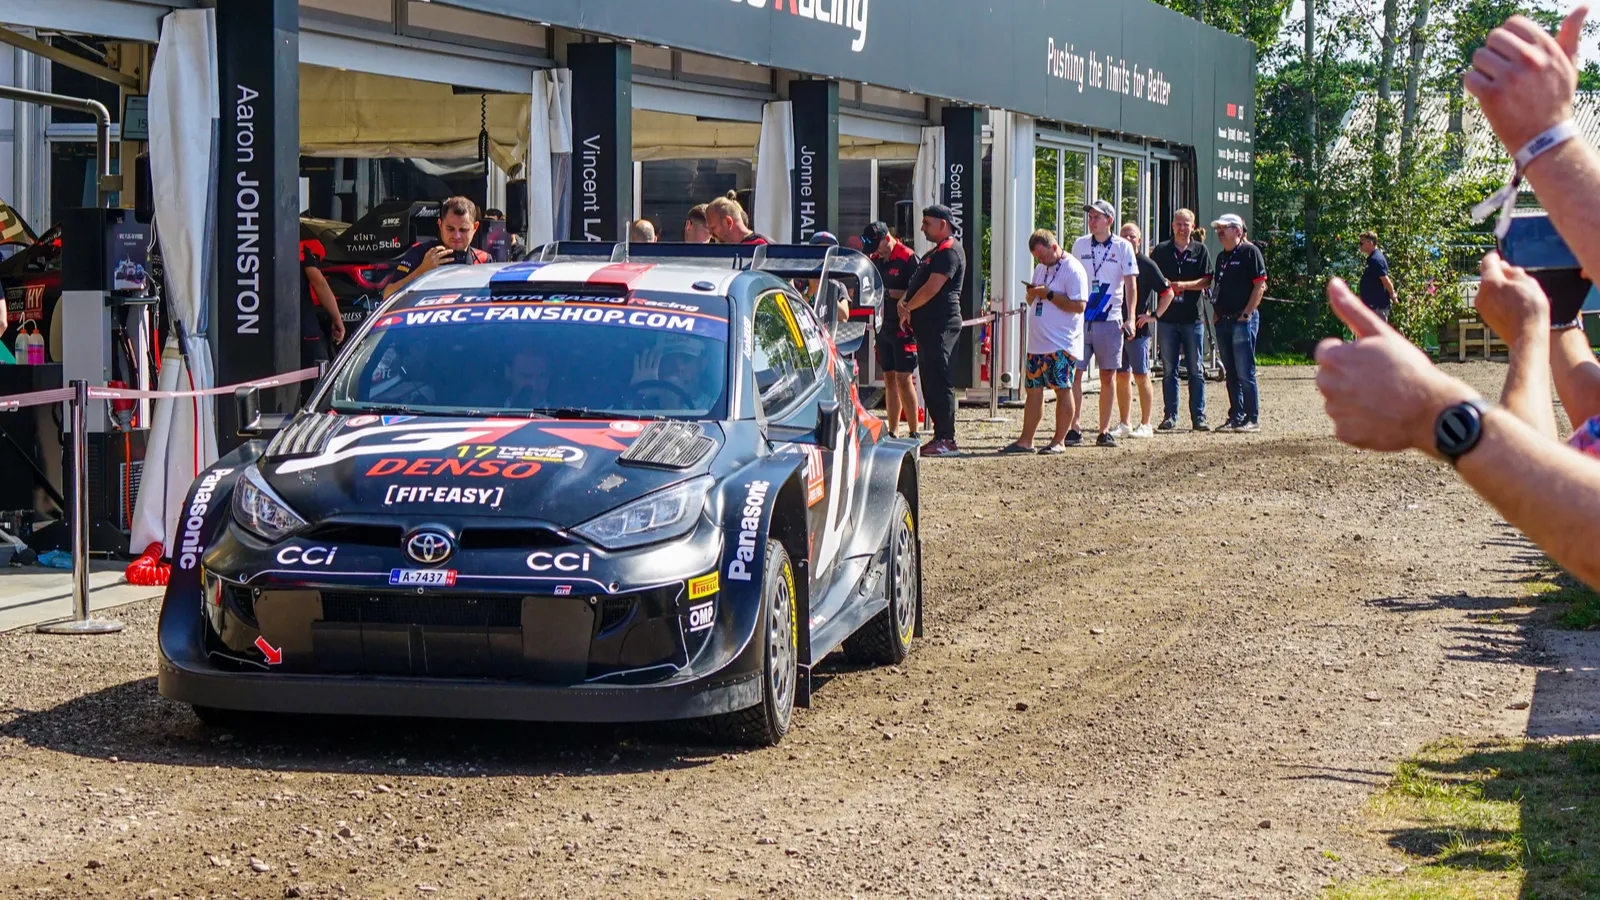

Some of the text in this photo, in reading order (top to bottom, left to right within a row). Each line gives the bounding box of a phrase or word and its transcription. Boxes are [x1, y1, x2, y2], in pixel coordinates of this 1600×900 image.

[1047, 37, 1171, 105] Pushing the limits for Better
[583, 134, 601, 212] Vincent
[800, 145, 816, 197] Jonne
[950, 163, 964, 199] Scott
[236, 84, 260, 334] Aaron JOHNSTON
[379, 238, 401, 249] Stilo
[28, 287, 43, 309] HY
[628, 298, 700, 313] Racing
[406, 306, 695, 331] WRC-FANSHOP.COM
[456, 445, 497, 459] 17
[365, 458, 542, 479] DENSO
[179, 467, 235, 570] Panasonic
[728, 480, 771, 581] Panasonic
[402, 571, 443, 583] A-7437
[690, 605, 714, 627] OMP
